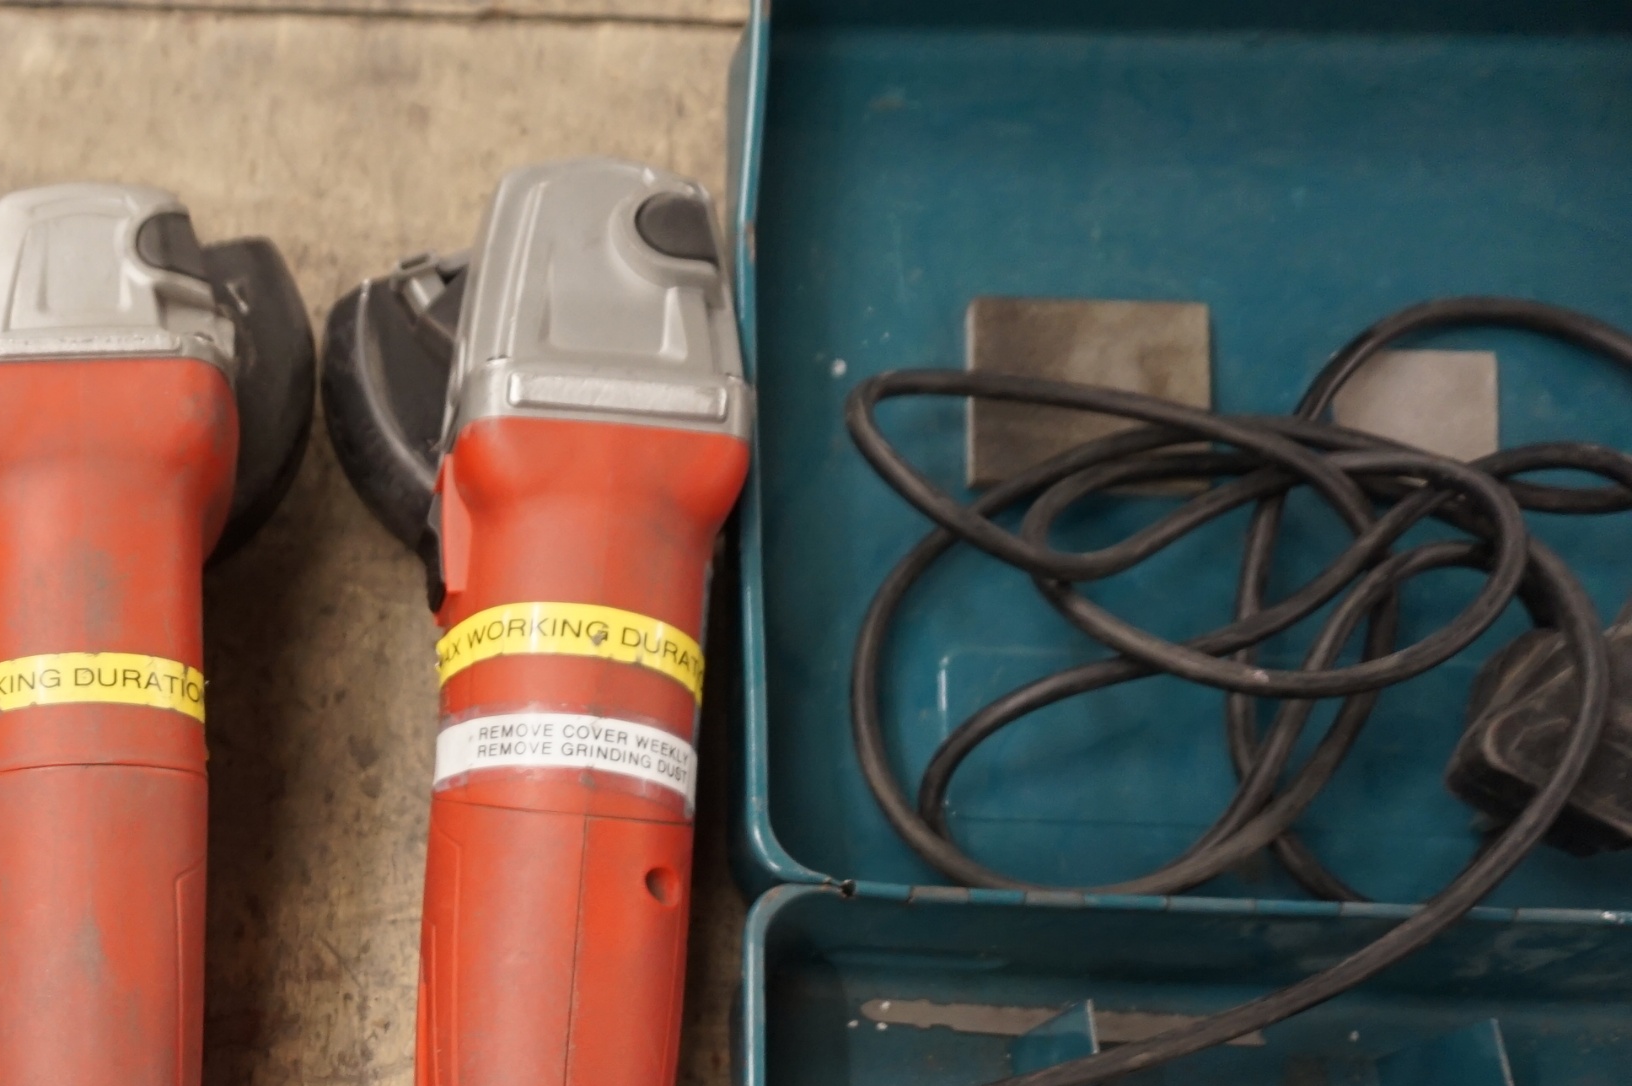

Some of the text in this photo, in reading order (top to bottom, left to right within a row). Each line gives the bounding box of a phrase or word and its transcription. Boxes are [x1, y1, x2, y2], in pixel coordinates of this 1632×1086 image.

[467, 617, 609, 649] WORKING
[74, 667, 203, 703] DURATIO
[477, 741, 688, 784] REMOVE GRINDING DUST
[478, 723, 689, 766] REMOVE COVER WEEKLY
